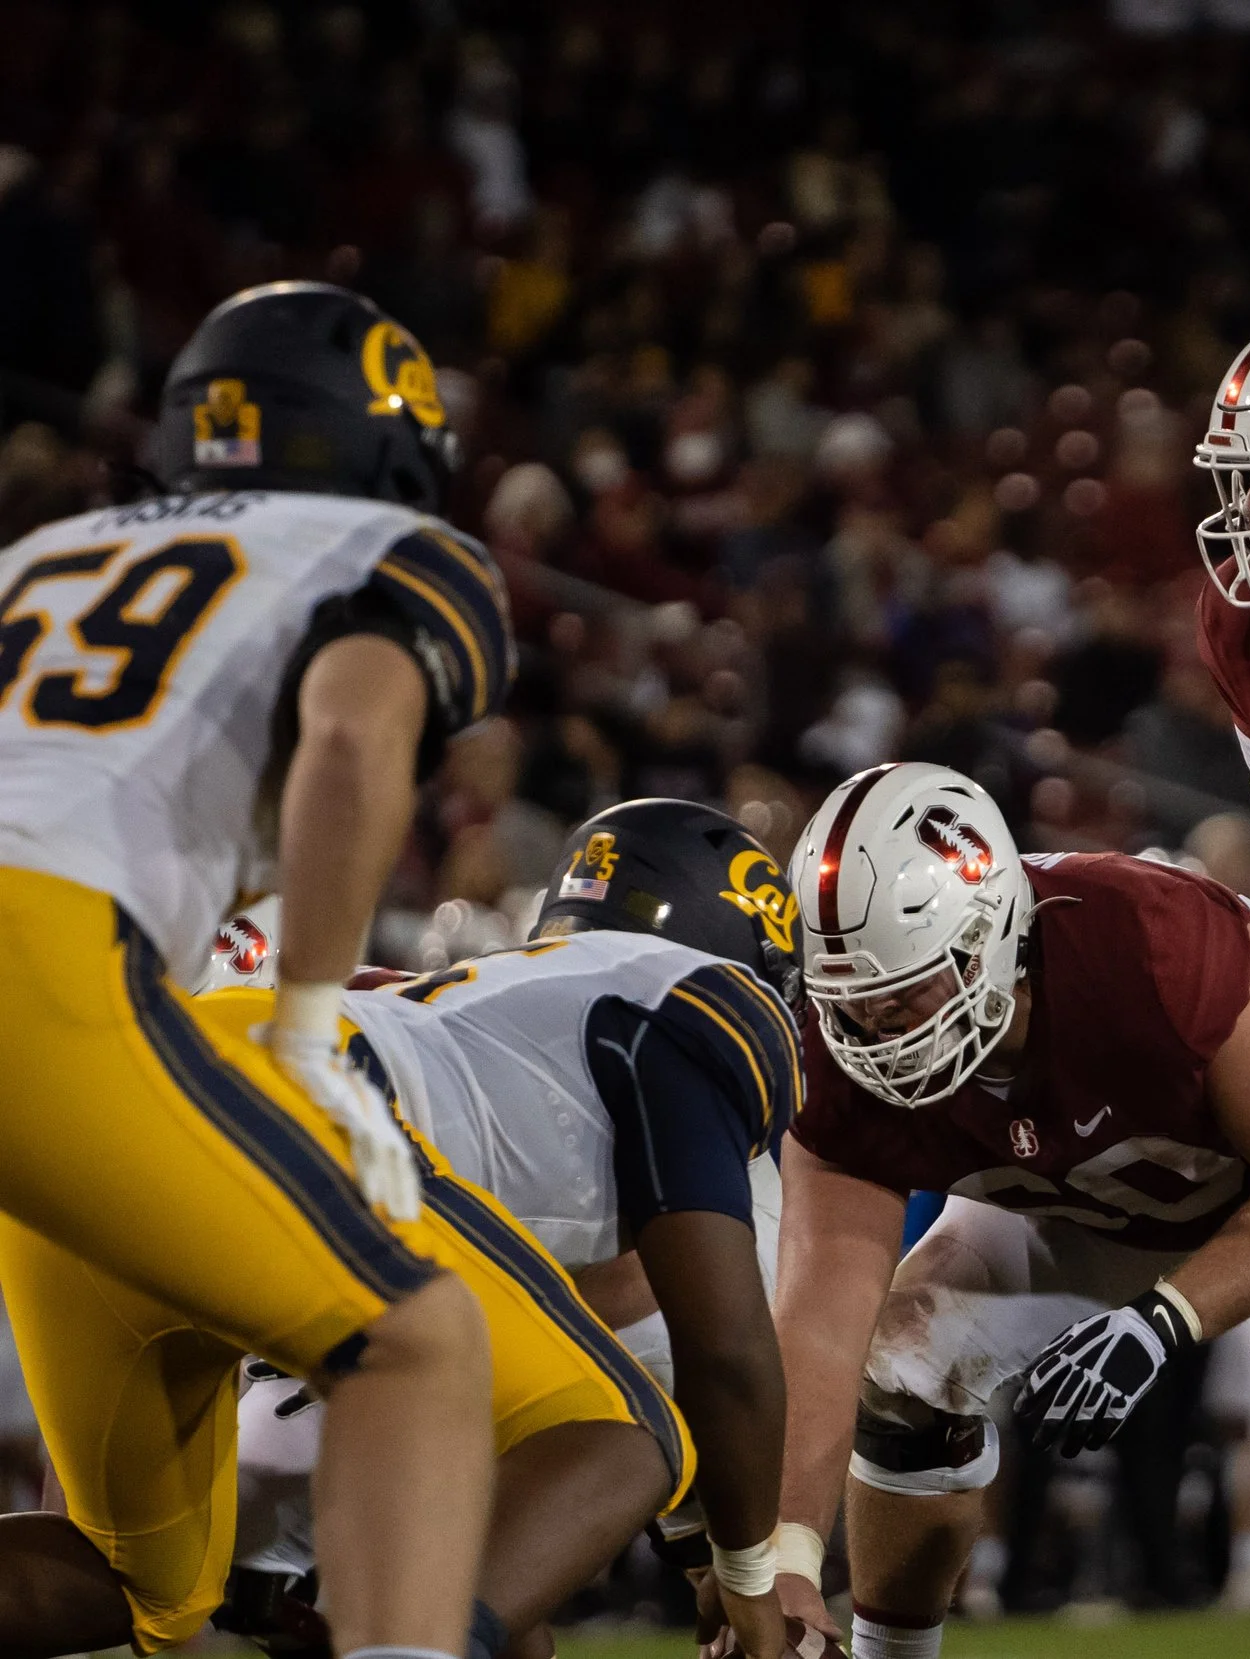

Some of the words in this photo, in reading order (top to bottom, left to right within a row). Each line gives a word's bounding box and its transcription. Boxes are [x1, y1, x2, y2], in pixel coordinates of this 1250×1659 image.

[361, 320, 446, 428] Cal
[0, 532, 248, 738] 59
[718, 849, 800, 953] Cal
